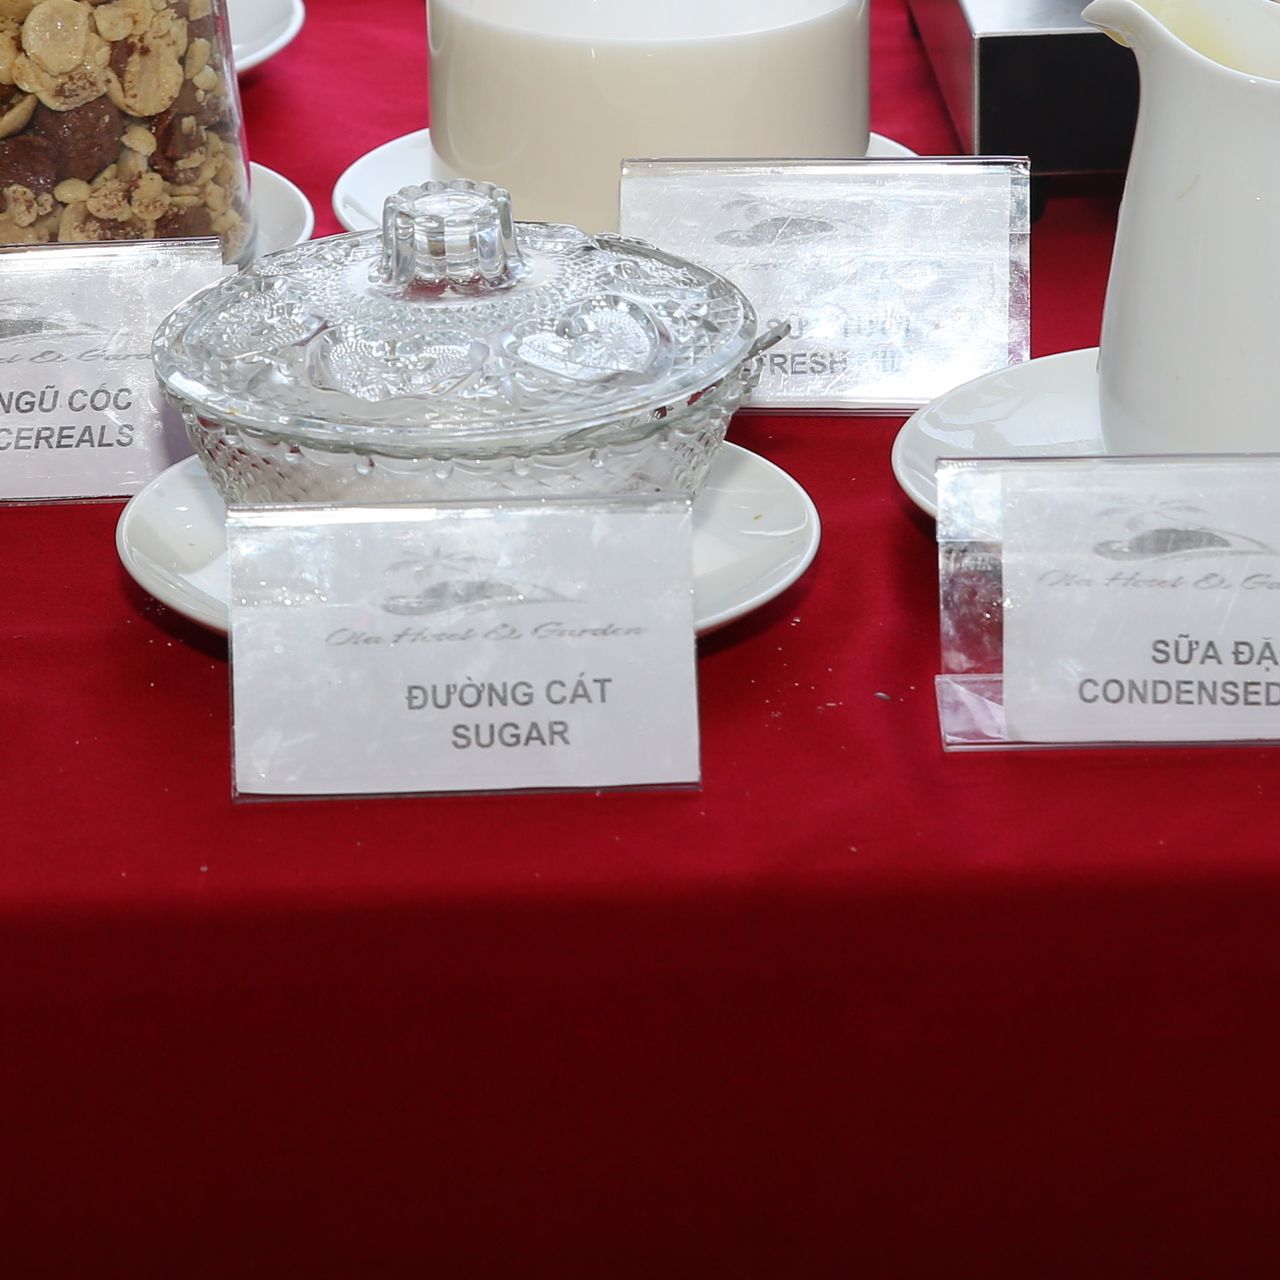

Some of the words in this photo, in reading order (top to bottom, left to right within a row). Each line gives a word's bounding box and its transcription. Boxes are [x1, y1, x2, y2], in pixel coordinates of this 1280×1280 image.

[1102, 571, 1186, 589] Hotel
[391, 626, 475, 645] Hotel
[531, 621, 644, 640] Garden
[1151, 634, 1223, 666] SỮA
[405, 676, 535, 710] ĐƯỜNG
[545, 672, 613, 705] CÁT
[451, 721, 570, 750] SUGAR
